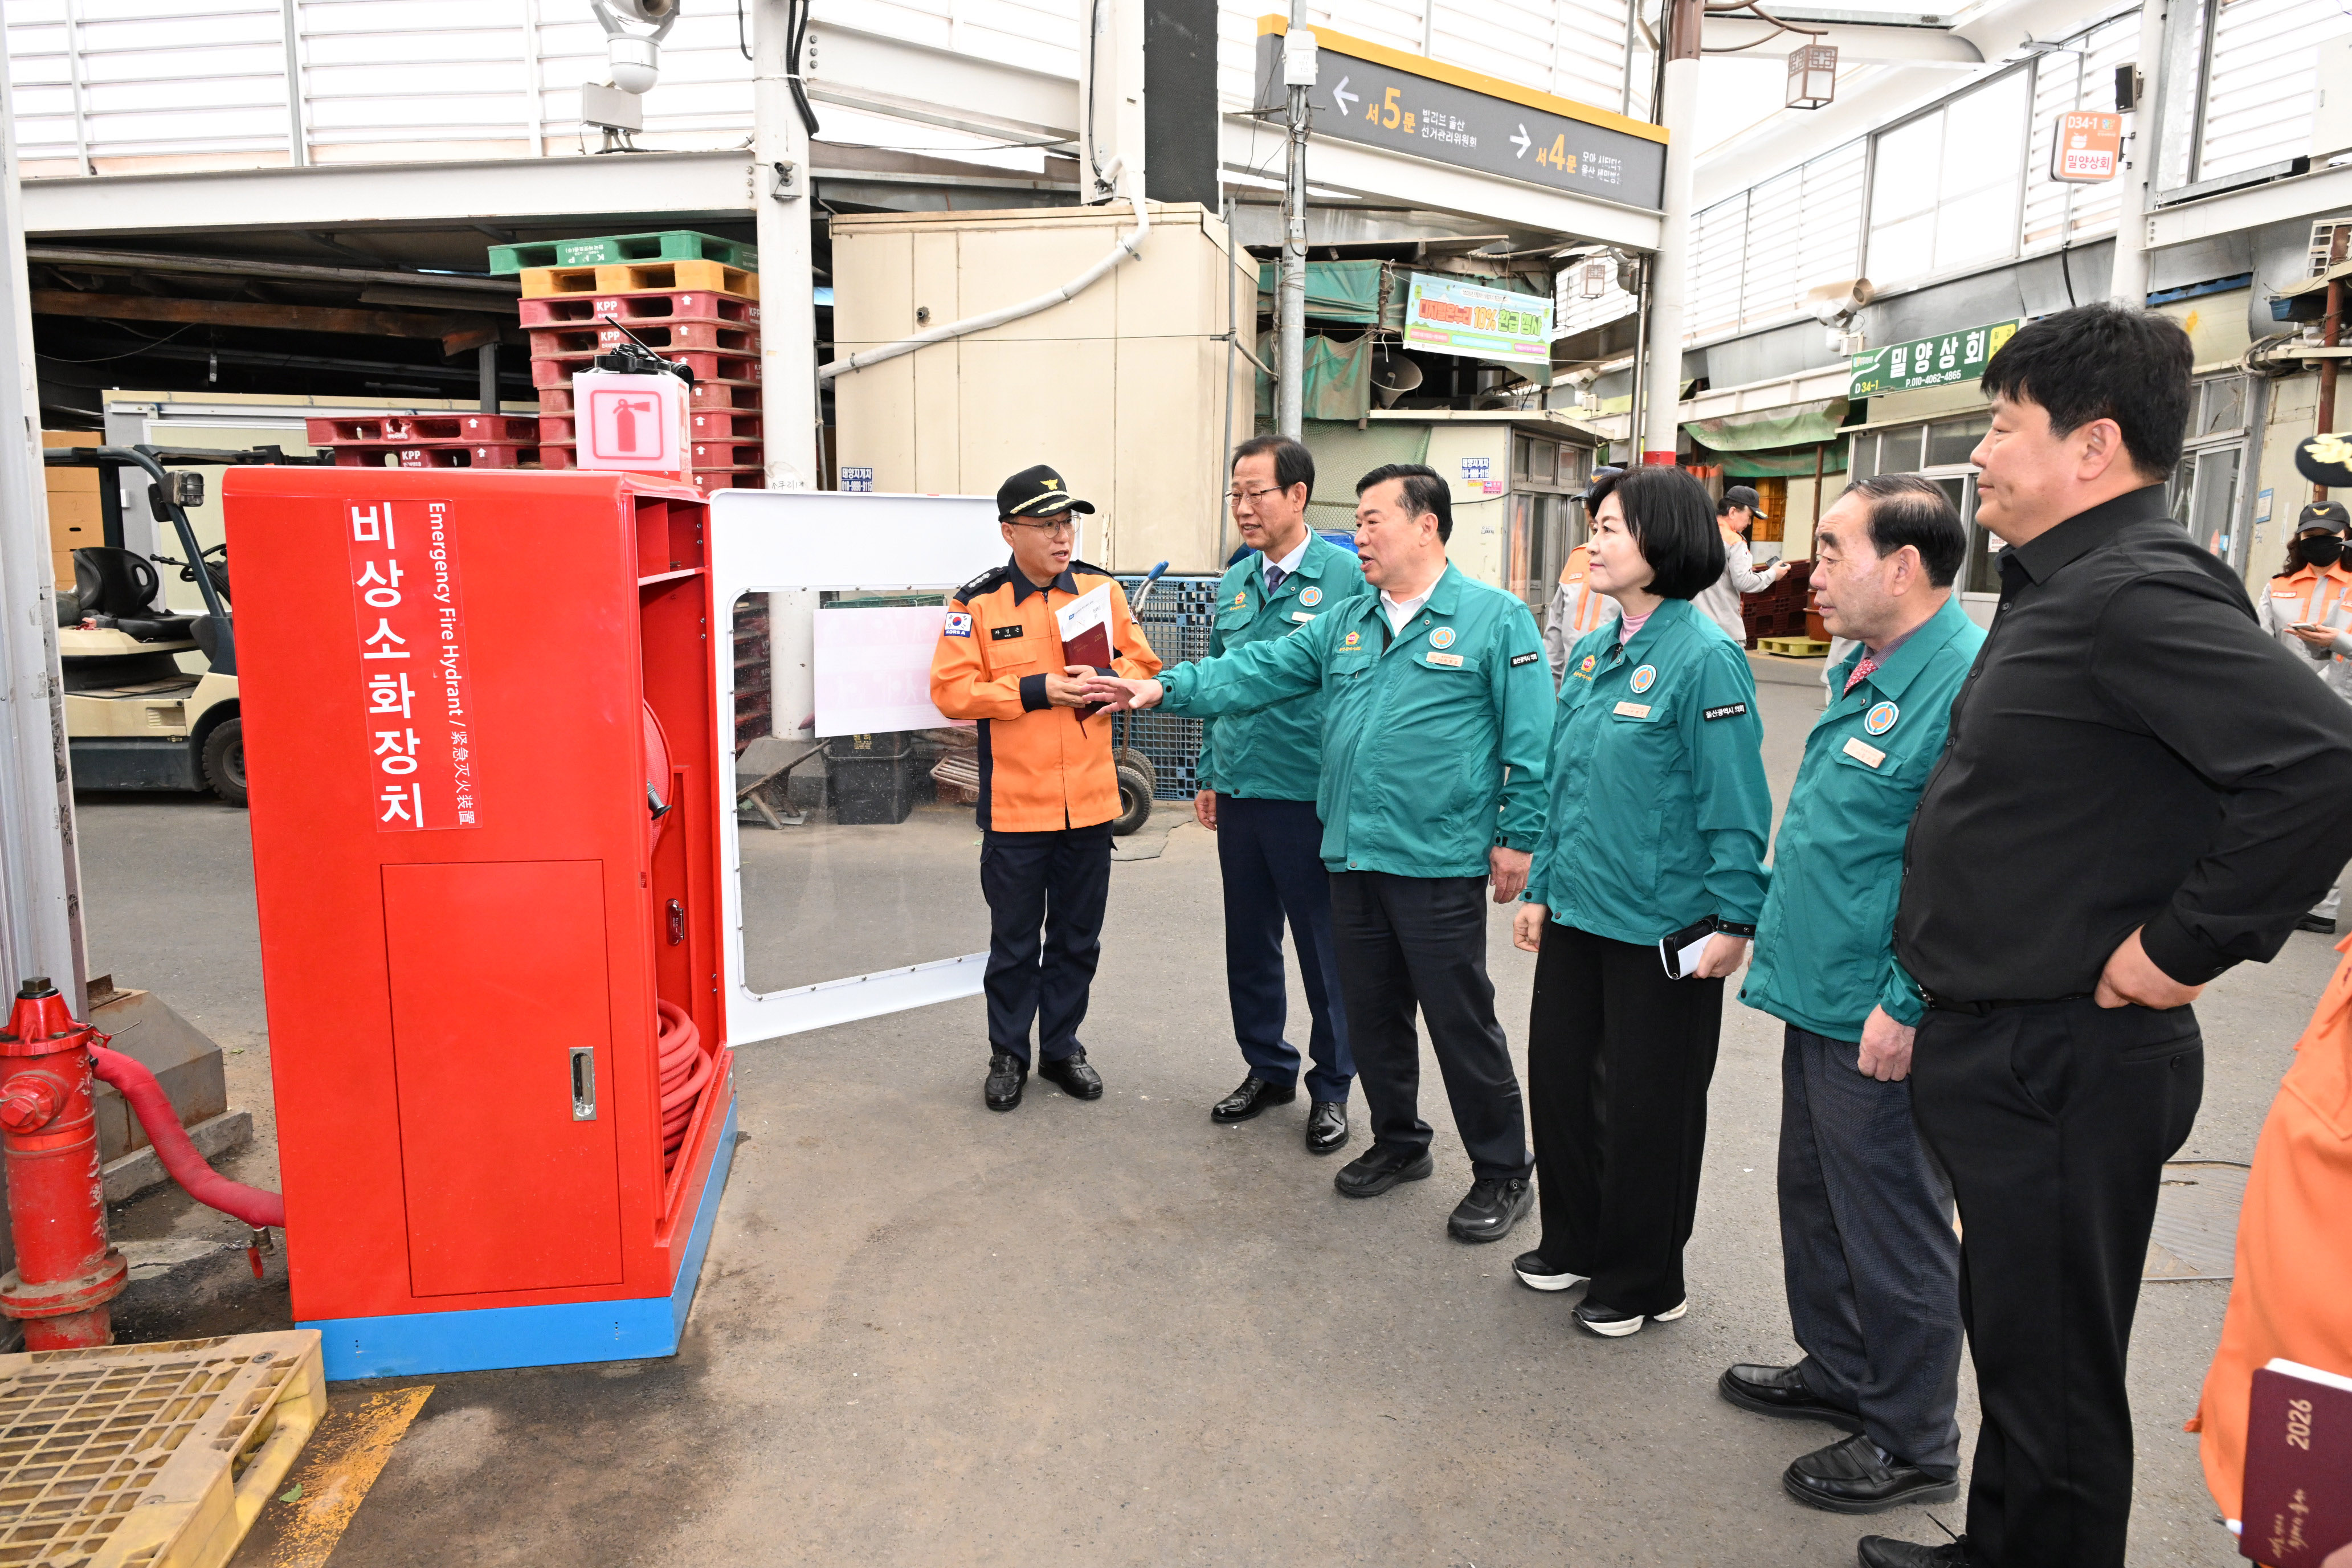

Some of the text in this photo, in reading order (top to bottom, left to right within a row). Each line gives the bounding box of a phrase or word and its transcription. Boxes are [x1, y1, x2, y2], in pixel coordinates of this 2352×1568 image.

[1366, 87, 1416, 134] 서5문
[1449, 116, 1465, 132] 울산
[2068, 116, 2098, 129] D34-1
[1422, 125, 1477, 149] 선거관리위원회
[1536, 133, 1577, 174] 서4문
[2068, 155, 2110, 170] 밀양상회
[597, 301, 618, 311] KPP
[1418, 298, 1472, 326] 디지털온누리
[1473, 306, 1497, 331] 10%
[1497, 308, 1520, 333] 환급
[1520, 312, 1542, 336] 행사
[601, 331, 620, 341] KPP
[1890, 330, 1986, 378] 밀양상회
[1855, 379, 1879, 394] D 34-1
[1905, 369, 1962, 388] P.010-4062-4865
[402, 450, 420, 460] KPP
[842, 468, 872, 479] 태양지게차
[428, 503, 450, 604] Emergency
[439, 608, 456, 640] Fire
[1094, 632, 1104, 642] 2026
[352, 502, 423, 828] 비상소화장치
[1513, 655, 1531, 665] 울산광역시
[440, 644, 463, 717] Hydrant
[1706, 704, 1745, 718] 울산광역시 의회
[451, 730, 475, 825] 紧急灭火装置
[2286, 1399, 2313, 1451] 2026
